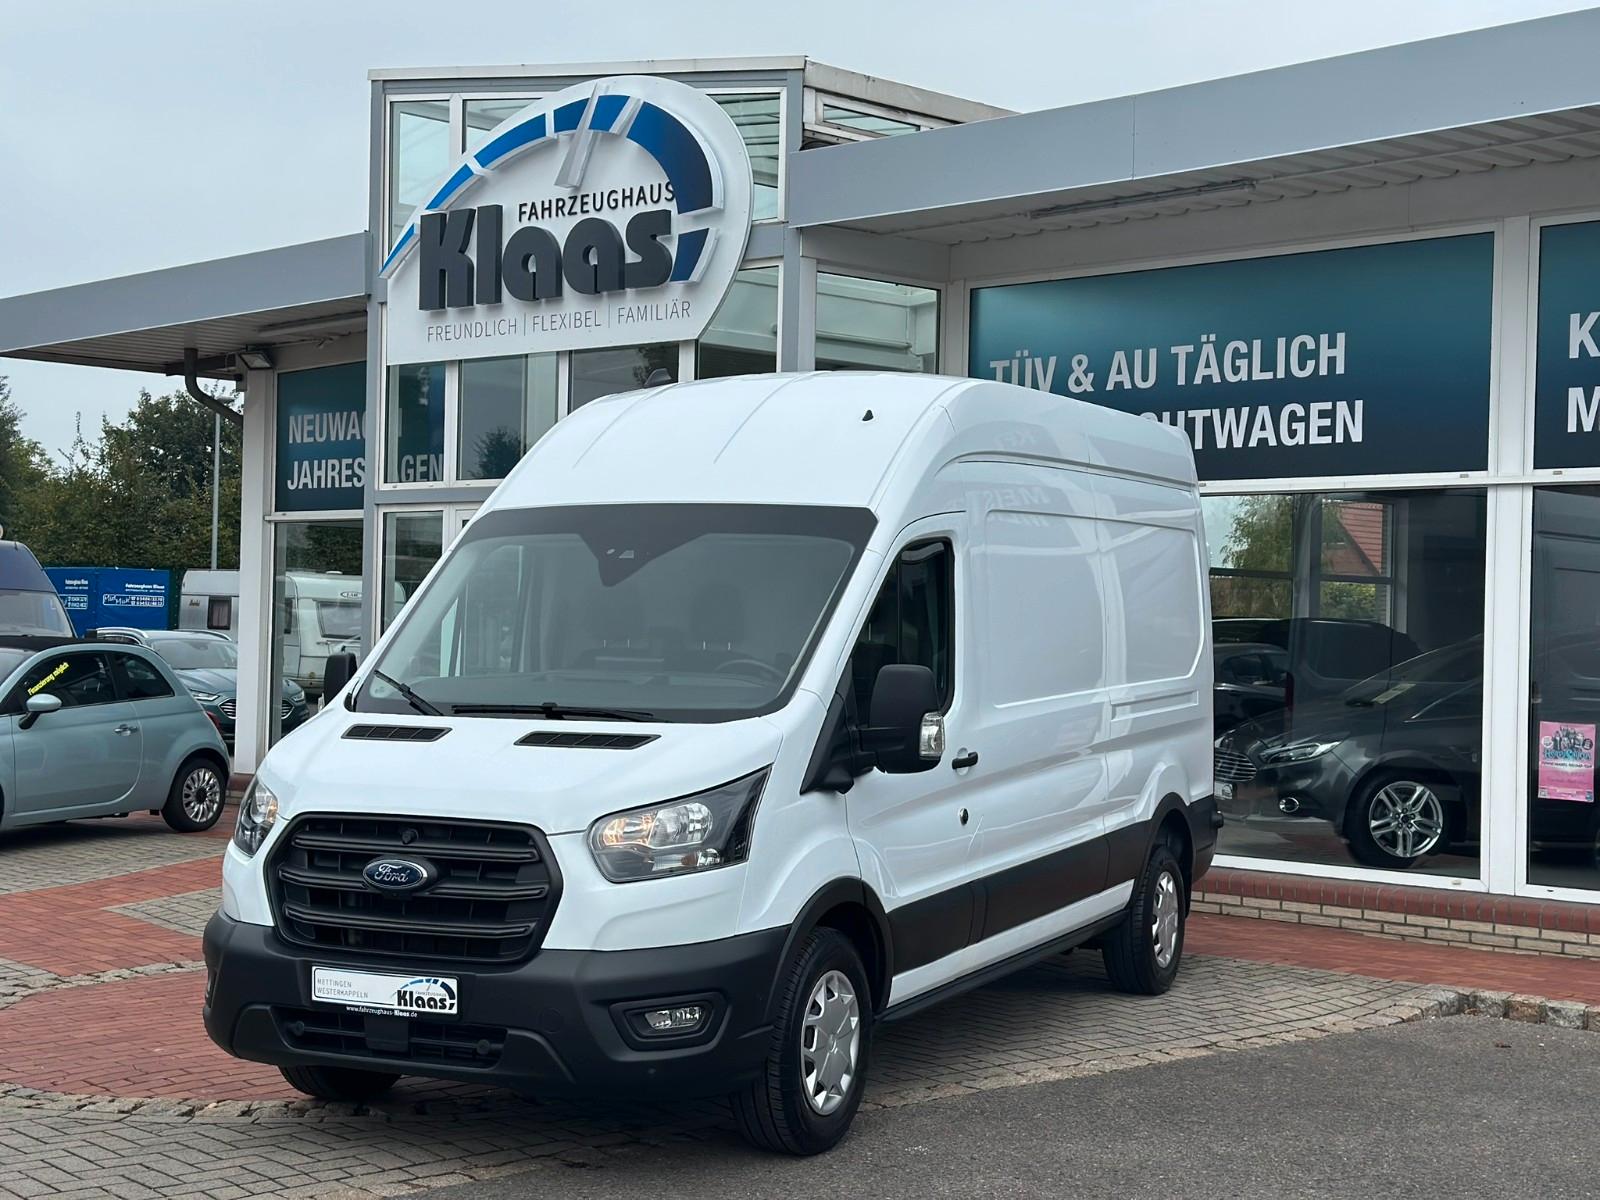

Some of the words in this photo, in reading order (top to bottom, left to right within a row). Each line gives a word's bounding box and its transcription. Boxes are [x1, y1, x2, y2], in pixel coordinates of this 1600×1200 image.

[518, 181, 675, 222] FAHRZEUGHAUS
[418, 204, 673, 311] Klaas
[427, 318, 517, 342] FREUNDLICH
[532, 310, 601, 333] FLEXIBEL
[617, 299, 691, 325] FAMILIÄR
[990, 349, 1057, 393] TÜV
[1068, 353, 1095, 394] &
[1106, 347, 1157, 392] AU
[1170, 332, 1346, 387] TÄGLICH
[374, 864, 410, 884] Ford
[397, 990, 448, 1010] Klaas
